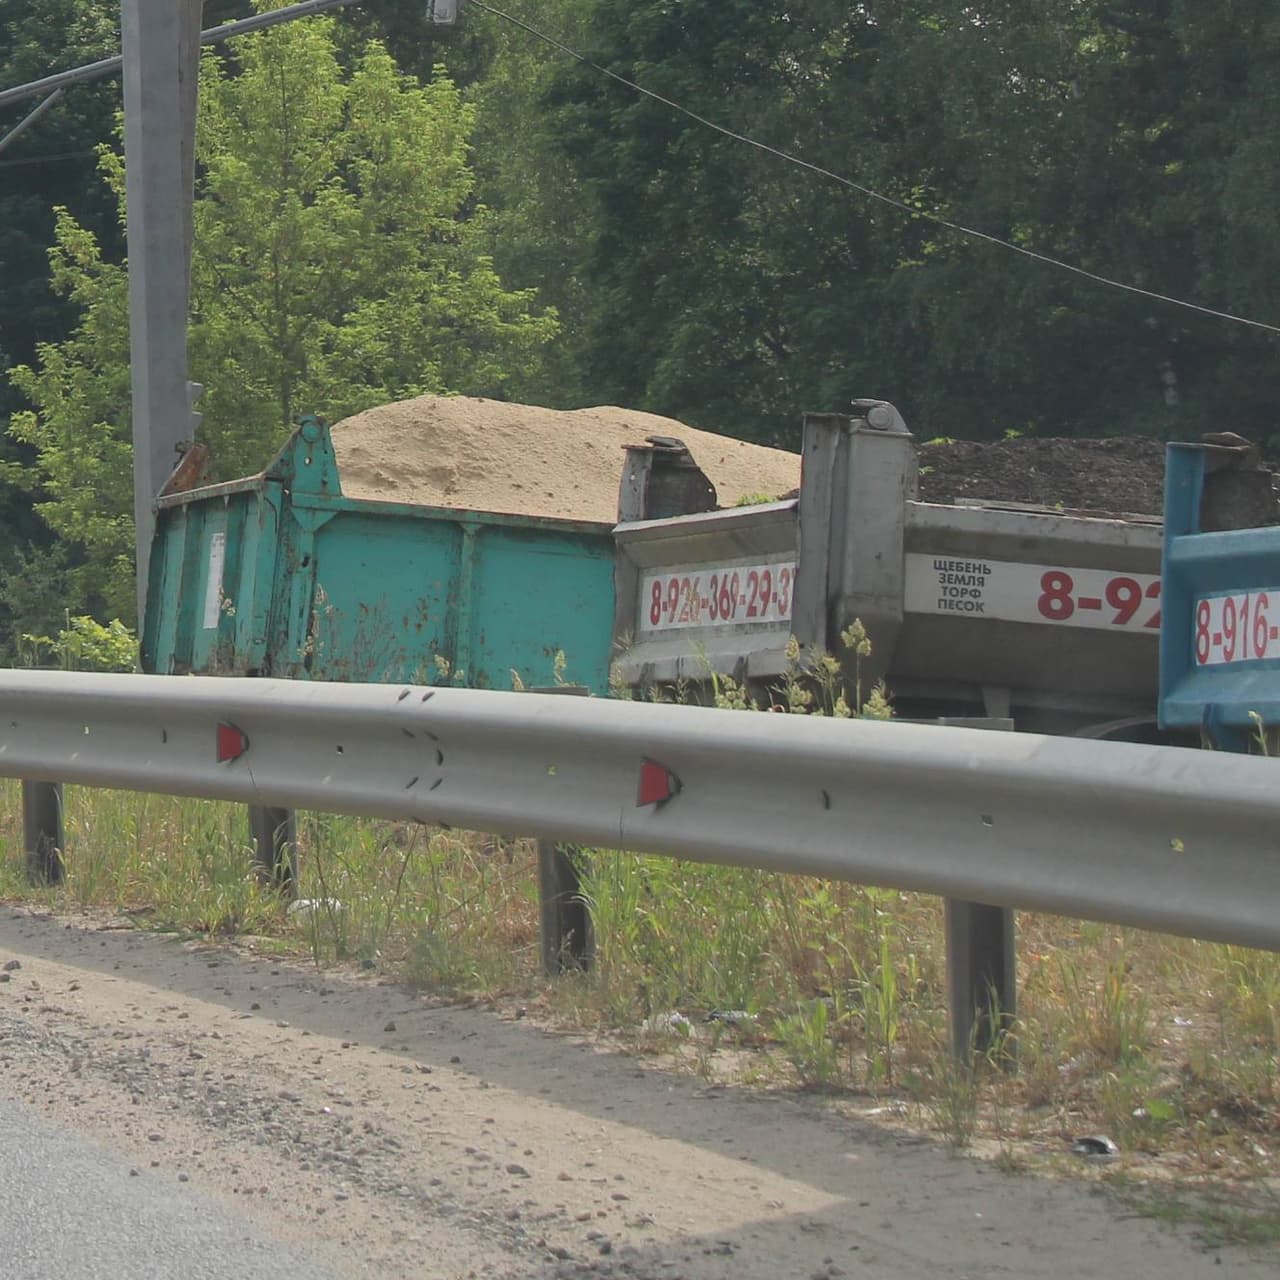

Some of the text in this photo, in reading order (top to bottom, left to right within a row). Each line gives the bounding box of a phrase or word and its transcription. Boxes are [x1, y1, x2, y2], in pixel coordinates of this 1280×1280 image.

[934, 560, 991, 575] ЩЕБЕНЬ
[939, 573, 984, 587] ЗЕМЛЯ
[650, 567, 798, 626] 8-926-369-29-3
[941, 586, 981, 598] ТОРФ
[938, 599, 984, 614] ПЕСОК
